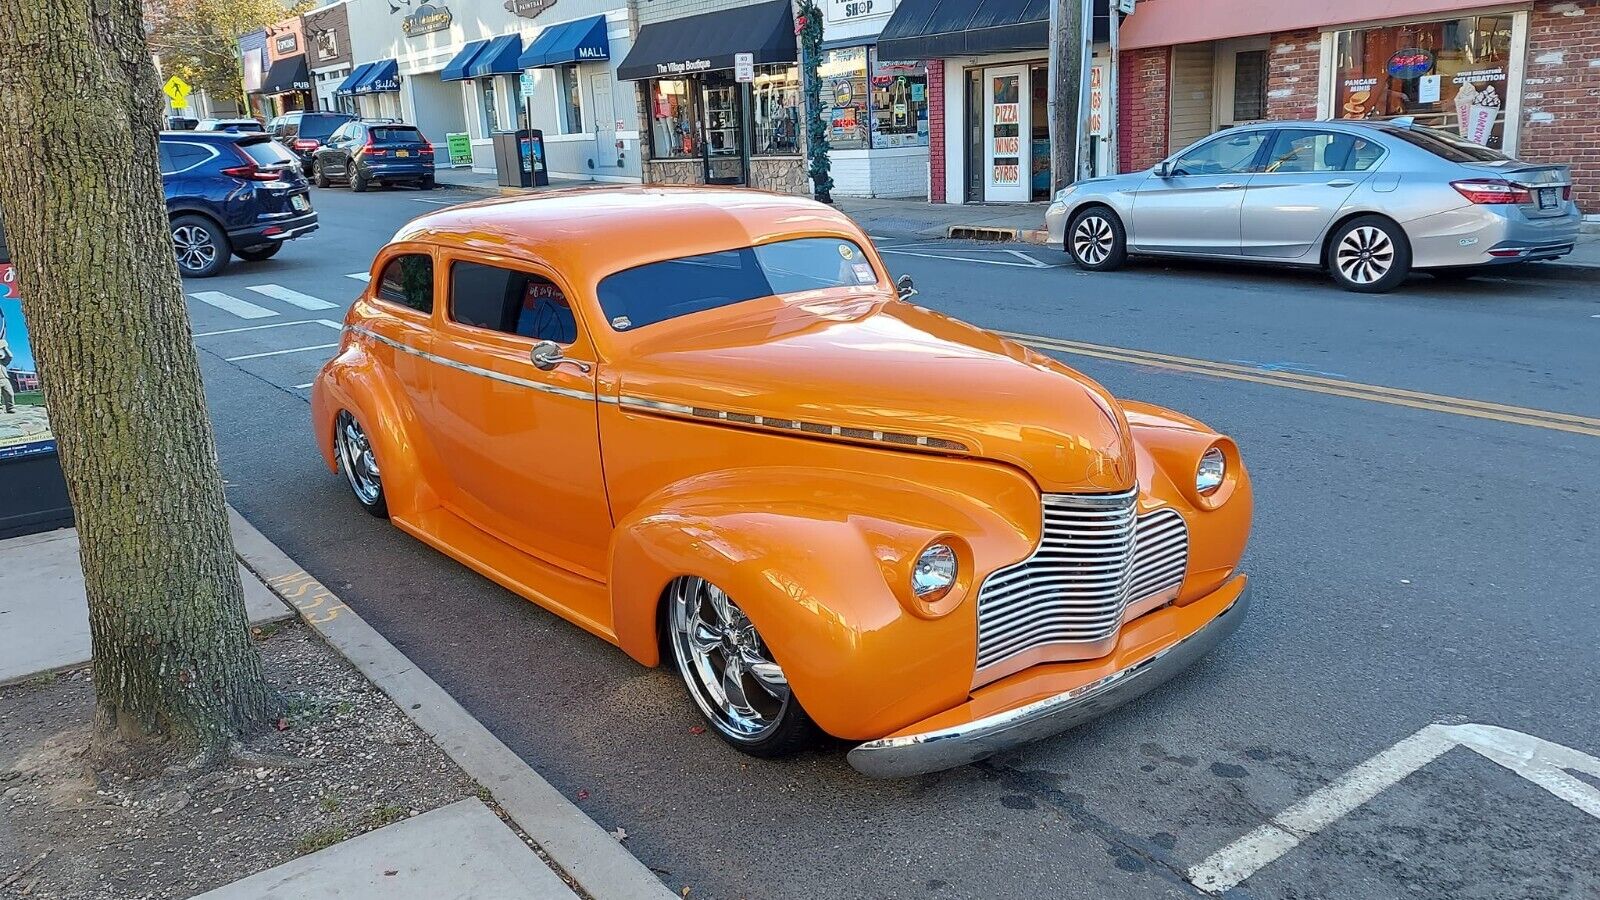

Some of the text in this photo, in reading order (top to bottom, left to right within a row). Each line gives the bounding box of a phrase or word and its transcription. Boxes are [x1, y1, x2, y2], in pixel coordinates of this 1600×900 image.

[845, 1, 873, 17] SHOP
[578, 46, 606, 58] MALL
[656, 59, 711, 74] The Village Boutique
[293, 81, 310, 89] PUB
[1344, 78, 1377, 86] PANCAKE
[1452, 73, 1506, 84] CELEBRATION
[995, 105, 1018, 123] PIZZA
[995, 138, 1019, 155] WINGS
[994, 166, 1018, 183] GYROS
